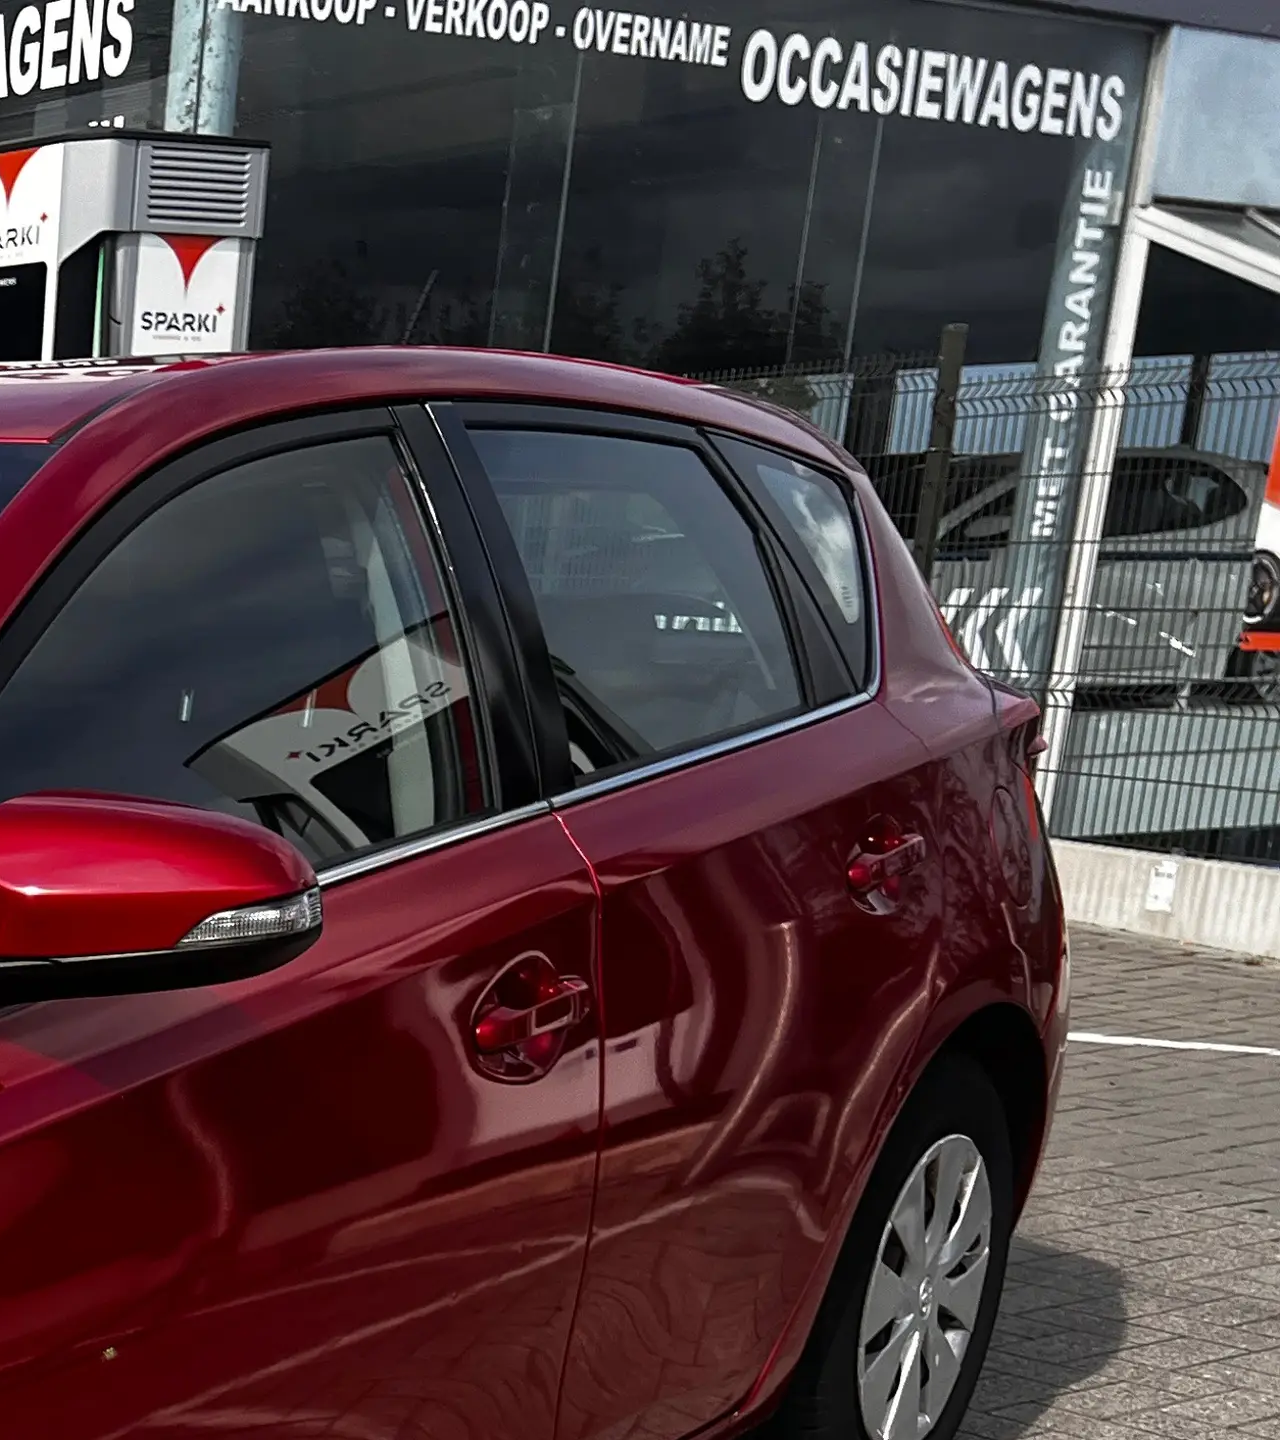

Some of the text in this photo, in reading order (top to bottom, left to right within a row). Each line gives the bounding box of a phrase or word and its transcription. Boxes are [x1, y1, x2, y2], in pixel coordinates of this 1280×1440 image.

[405, 0, 549, 45] VERKOOP
[572, 7, 731, 67] OVERNAME
[741, 29, 1126, 142] OCCASIEWAGENS
[140, 311, 217, 333] SPARKI
[1049, 168, 1113, 424] GARANTIE
